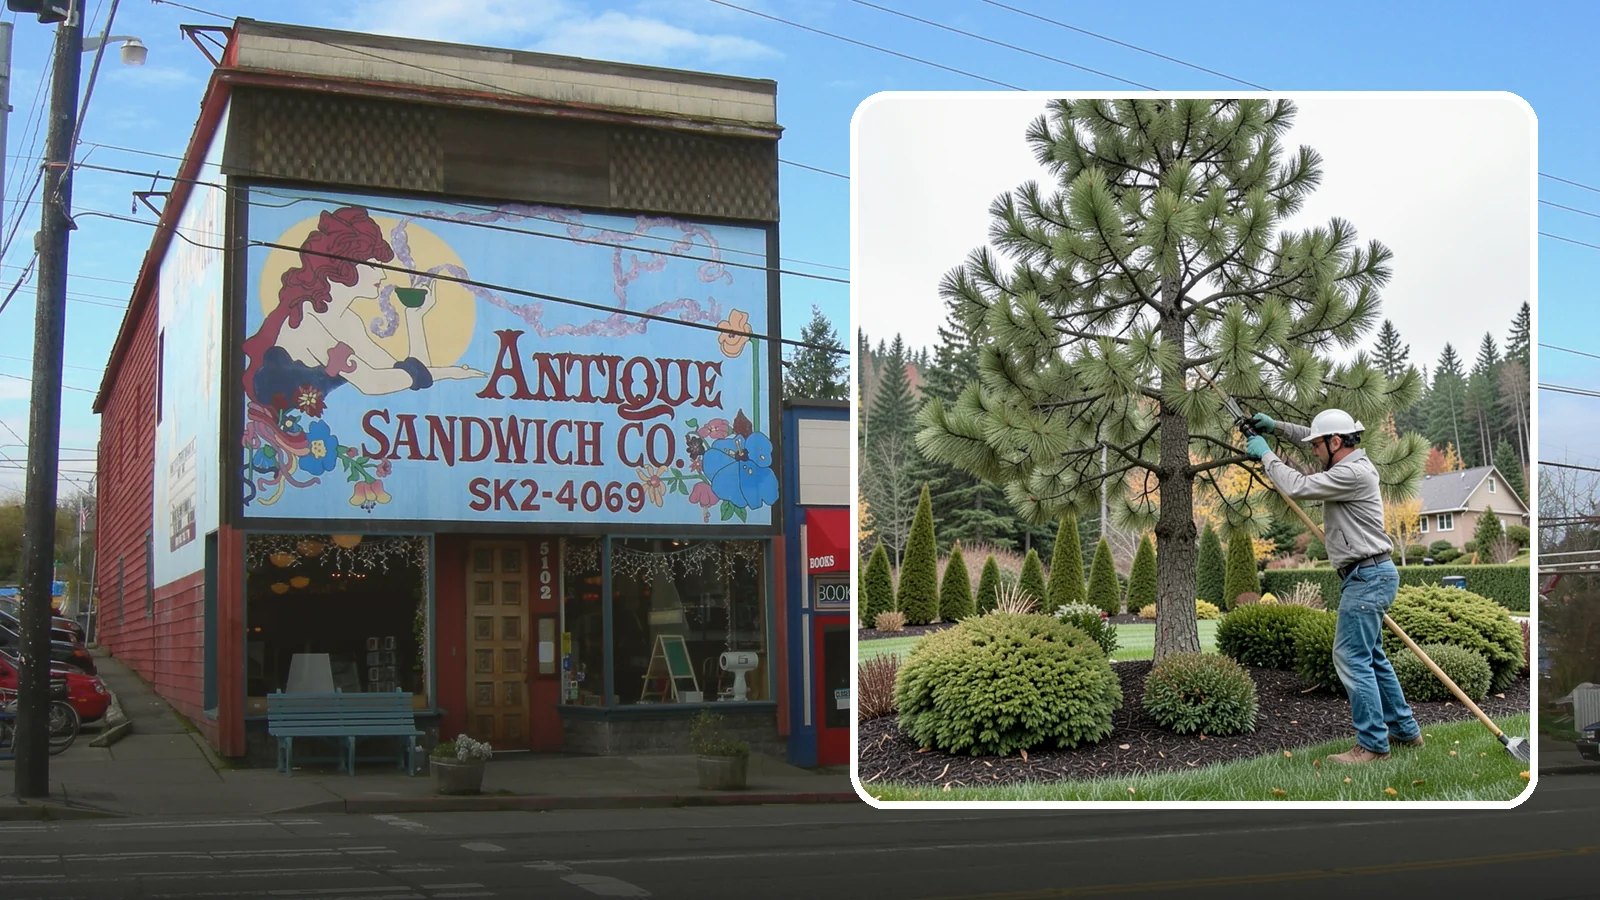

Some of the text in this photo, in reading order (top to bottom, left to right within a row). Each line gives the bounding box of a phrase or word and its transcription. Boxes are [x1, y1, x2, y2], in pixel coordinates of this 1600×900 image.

[475, 328, 724, 421] ANTIQUE
[361, 408, 685, 469] SANDWICH CO.
[468, 477, 646, 513] SK2-4069
[540, 542, 551, 599] 5102
[809, 554, 835, 569] BOOKS
